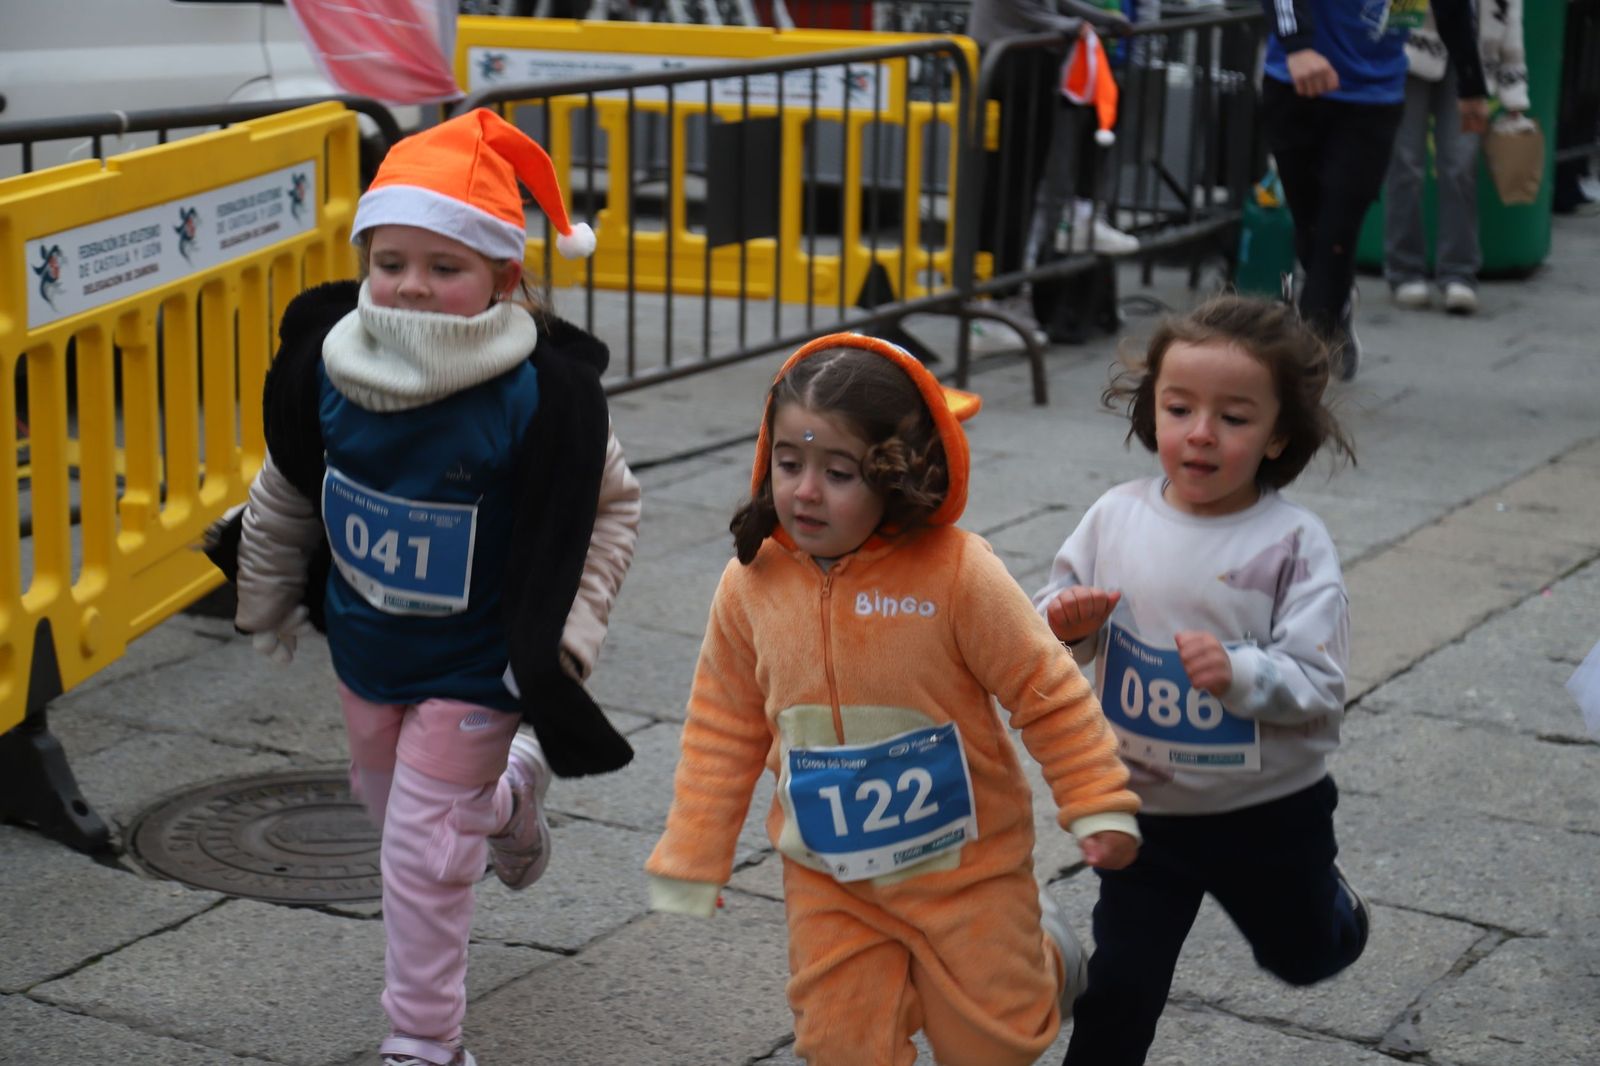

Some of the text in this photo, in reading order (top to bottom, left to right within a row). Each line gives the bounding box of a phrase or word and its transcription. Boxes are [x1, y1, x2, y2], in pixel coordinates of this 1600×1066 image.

[336, 483, 354, 503] Cross
[354, 494, 366, 509] del
[366, 498, 389, 517] Duero
[345, 513, 431, 580] 041
[1140, 648, 1164, 667] Duero
[1120, 666, 1224, 730] 086
[802, 757, 827, 769] Cross
[827, 757, 841, 769] del
[841, 758, 867, 770] Duero
[818, 767, 939, 837] 122
